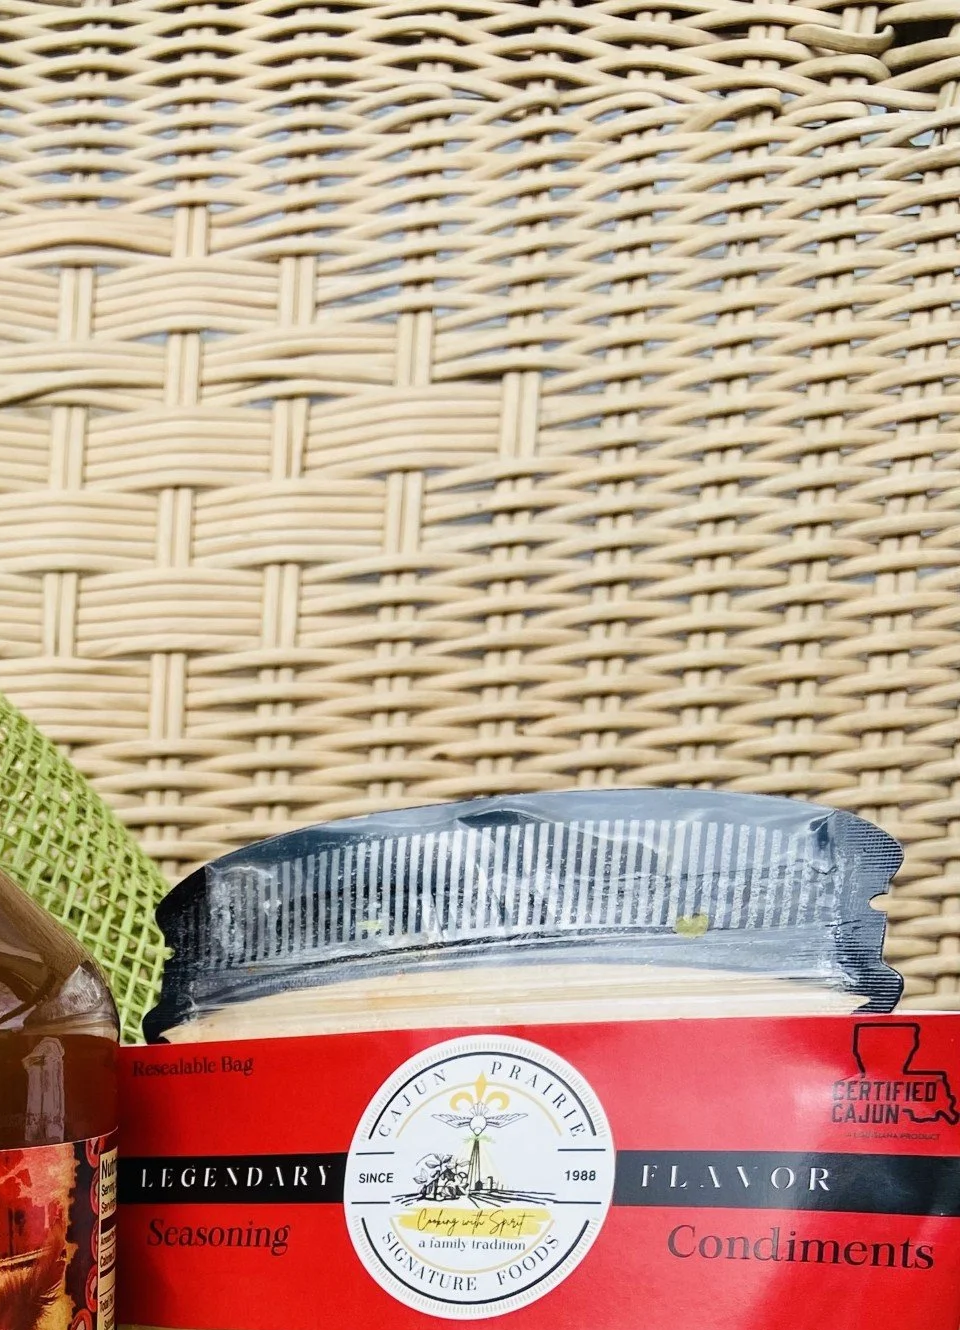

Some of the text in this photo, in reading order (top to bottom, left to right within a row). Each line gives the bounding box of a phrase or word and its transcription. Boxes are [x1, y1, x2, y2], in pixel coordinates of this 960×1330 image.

[132, 1056, 253, 1076] Resealable Bag
[378, 1061, 586, 1138] CAJUN PRAIRIE
[832, 1080, 936, 1102] CERTIFIED
[831, 1103, 899, 1124] CAJUN
[142, 1165, 334, 1188] LEGENDARY
[359, 1173, 394, 1184] SINCE
[564, 1170, 596, 1181] 1988
[641, 1165, 831, 1191] FLAVOR
[417, 1209, 534, 1236] Cooking with Spirit
[147, 1219, 290, 1256] Seasoning
[419, 1238, 526, 1252] a family tradition
[667, 1224, 935, 1270] Condiments
[382, 1232, 560, 1291] SIGNATURE FOODS
